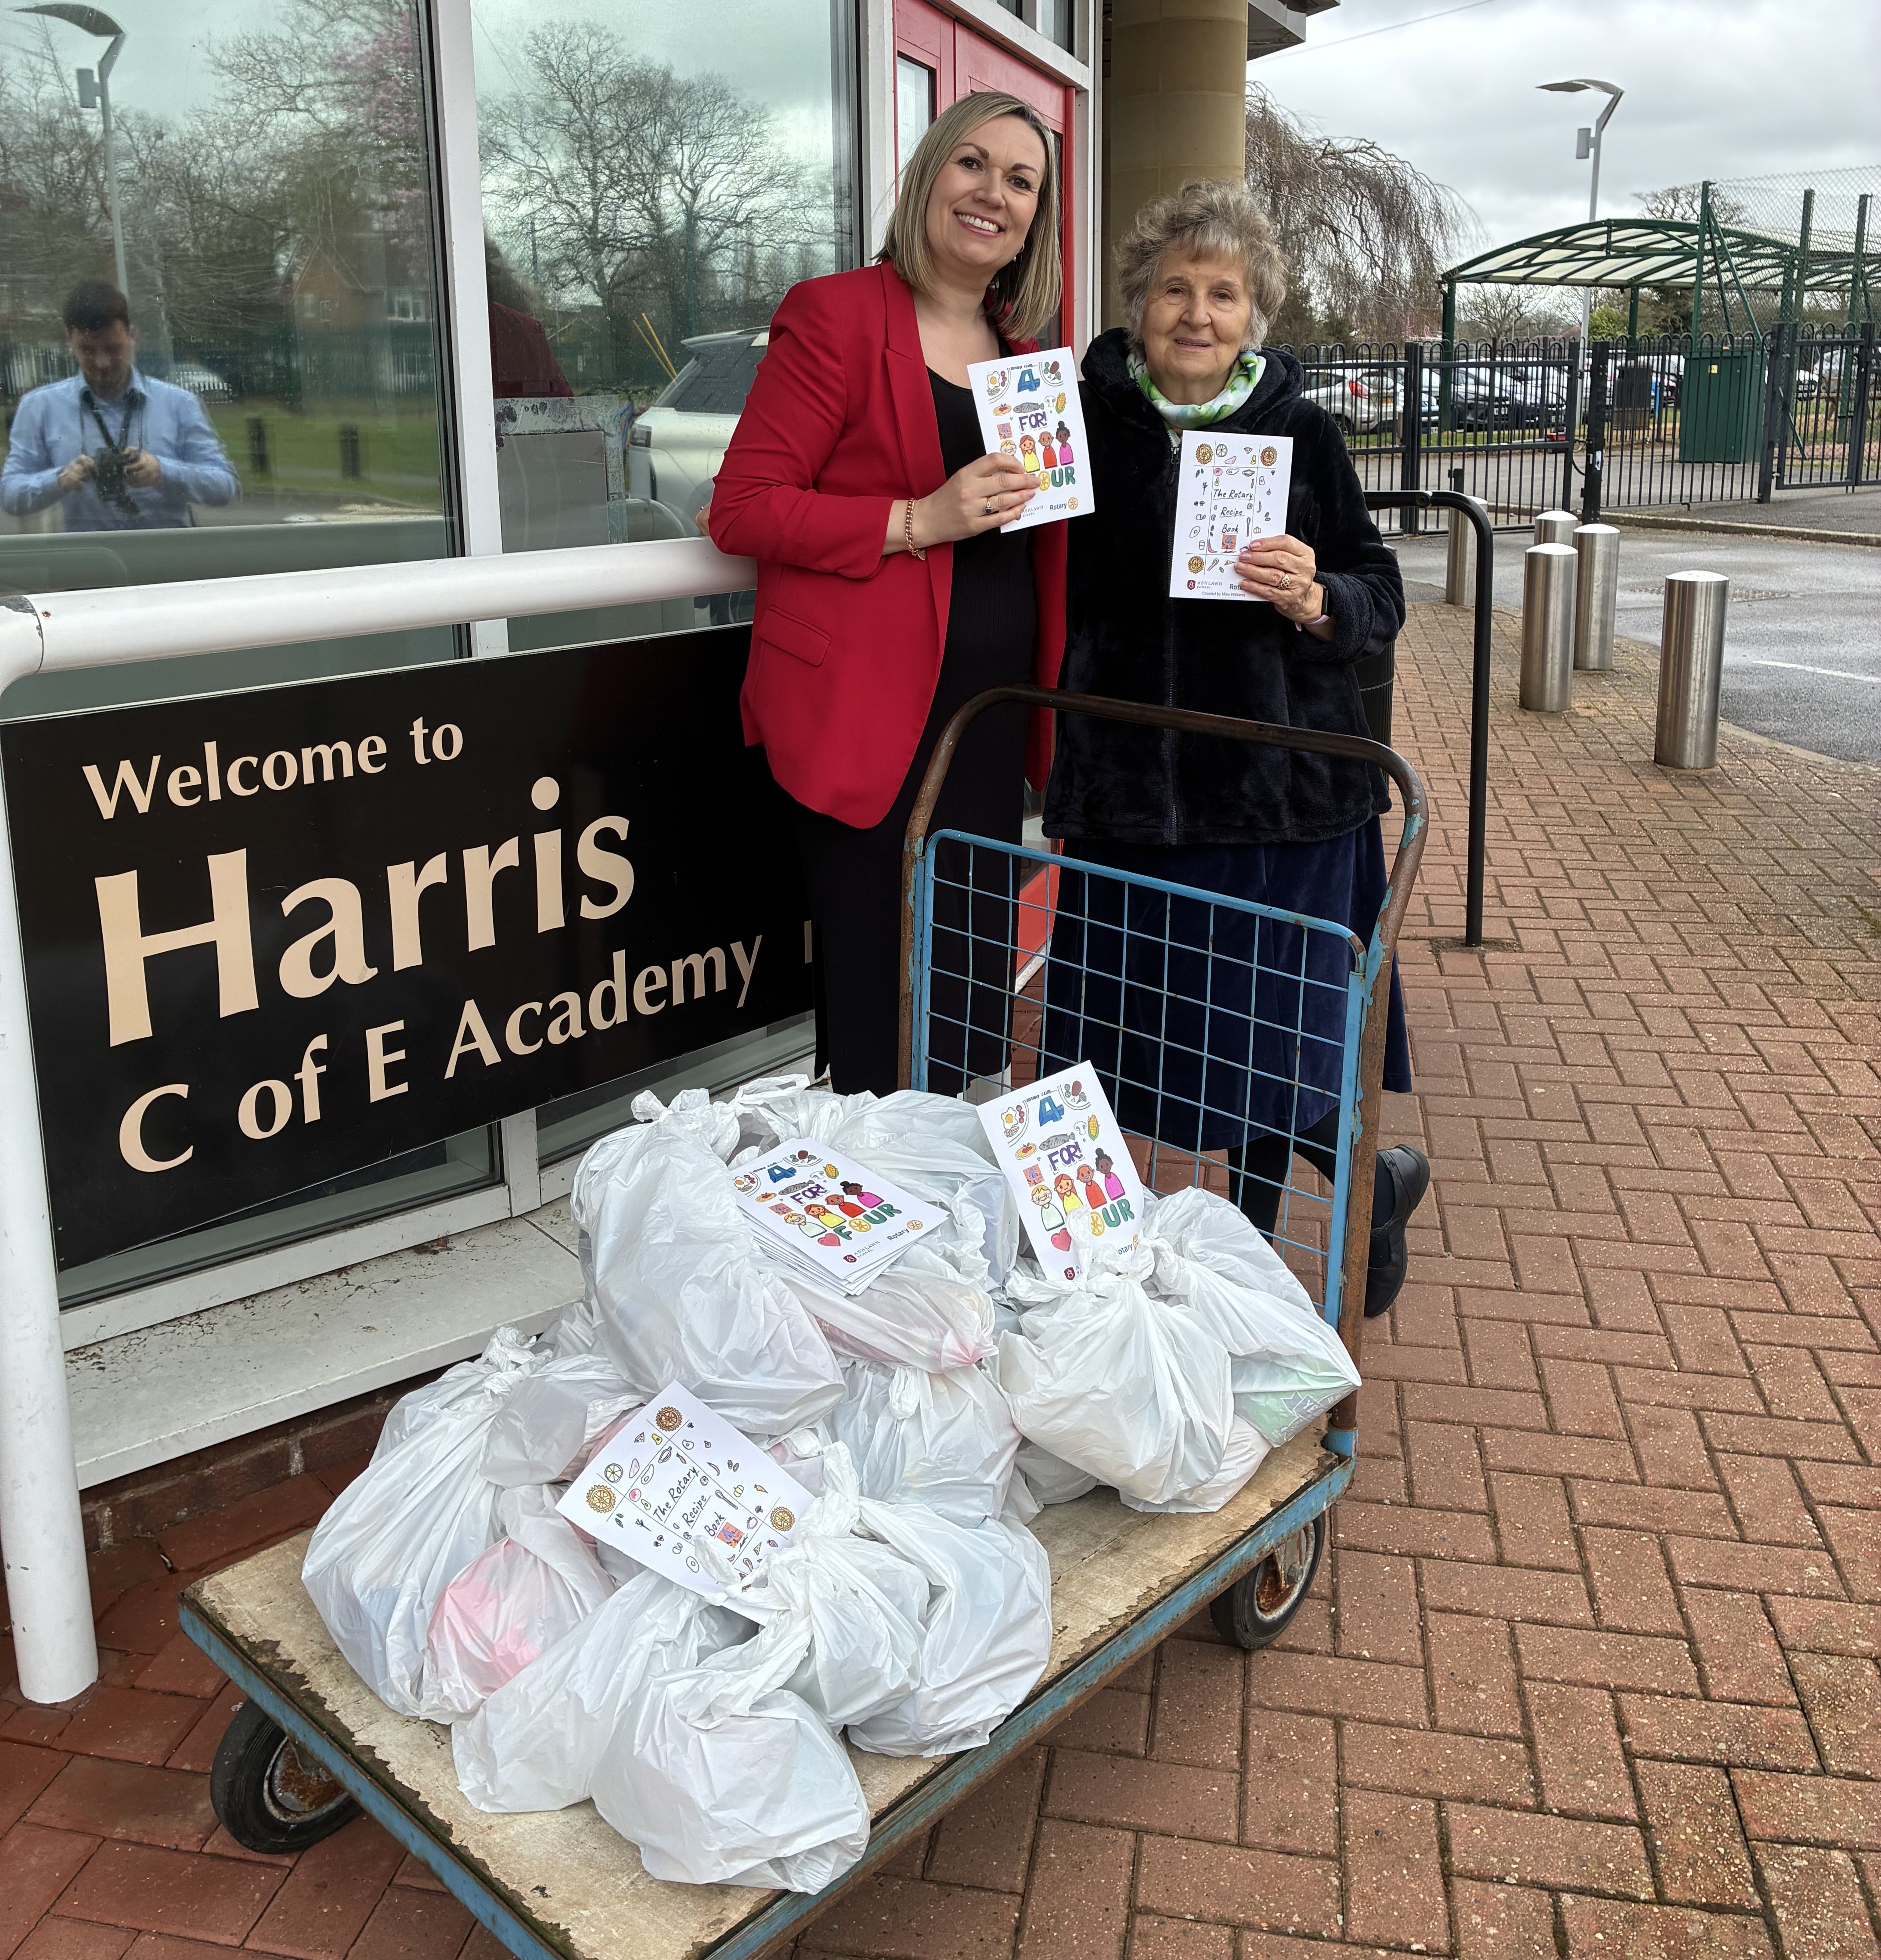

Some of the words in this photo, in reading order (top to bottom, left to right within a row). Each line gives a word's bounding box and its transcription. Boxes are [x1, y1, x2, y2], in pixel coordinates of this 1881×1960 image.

[1017, 369, 1040, 393] 4
[1019, 411, 1048, 432] FOR!
[1214, 489, 1226, 498] The
[1229, 489, 1253, 501] Rotary
[1220, 507, 1243, 517] Recipe
[1222, 524, 1239, 533] Book
[82, 736, 386, 820] Welcome
[410, 716, 463, 764] to
[95, 777, 634, 1047] Harris
[119, 1084, 193, 1172] C
[238, 1034, 328, 1139] of
[366, 1020, 408, 1103] E
[444, 935, 762, 1079] Academy
[1039, 1096, 1064, 1127] 4
[1047, 1141, 1083, 1171] FOR!
[768, 1165, 796, 1183] 4
[790, 1184, 828, 1205] FOR!
[833, 1204, 902, 1240] FOUR
[887, 1228, 910, 1241] Rotary
[854, 1241, 880, 1255] ASHLAWN
[857, 1249, 873, 1258] SCHOOL
[1118, 1244, 1132, 1255] otary
[653, 1502, 671, 1521] The
[668, 1466, 698, 1503] Rotary
[681, 1495, 706, 1527] Recipe
[704, 1511, 725, 1536] Book
